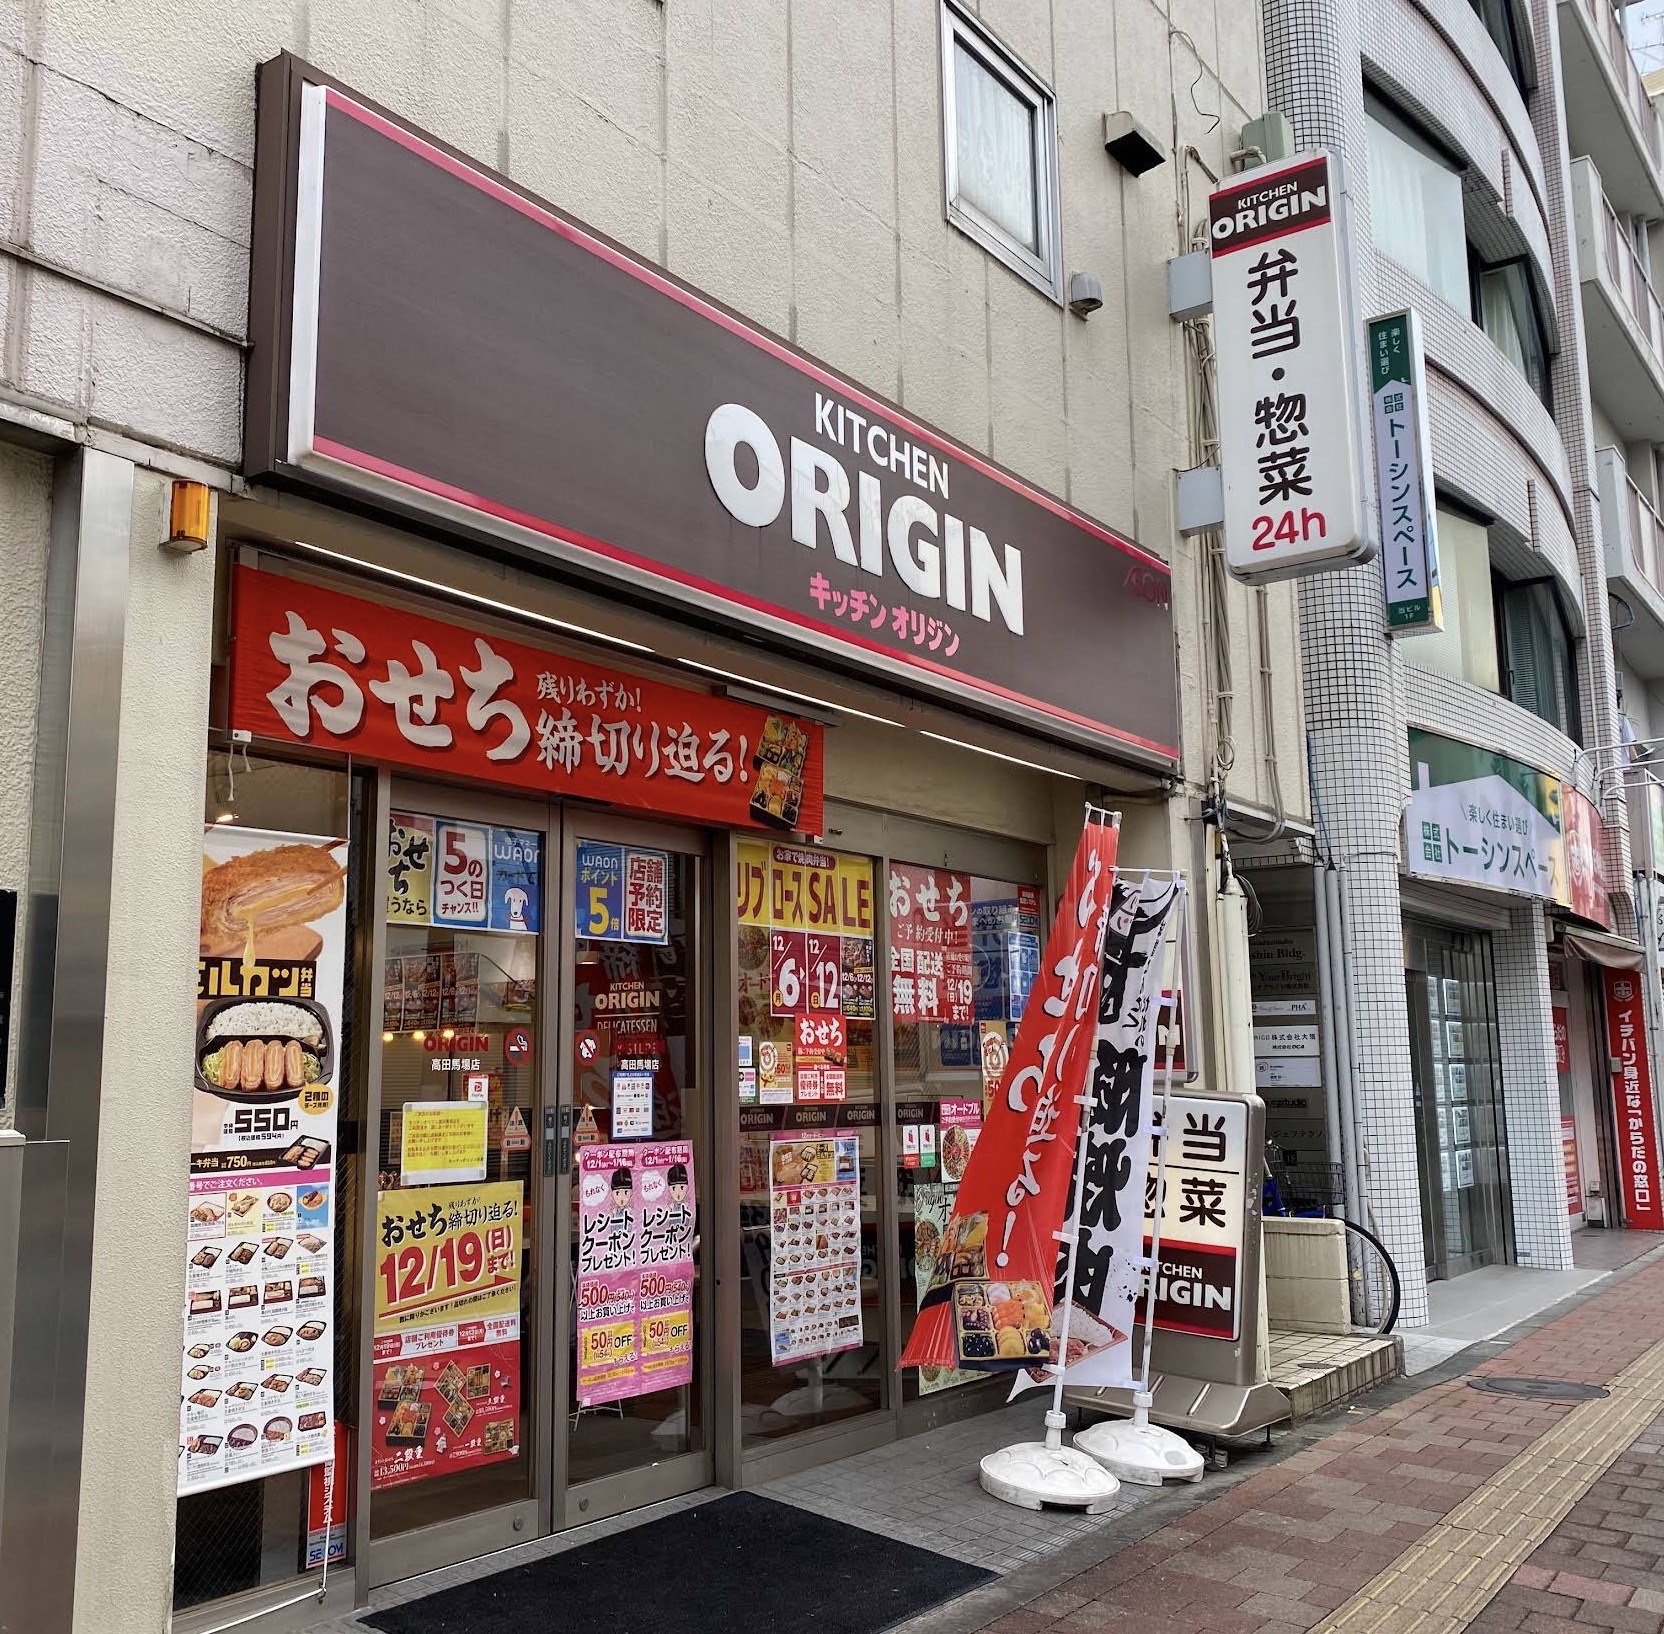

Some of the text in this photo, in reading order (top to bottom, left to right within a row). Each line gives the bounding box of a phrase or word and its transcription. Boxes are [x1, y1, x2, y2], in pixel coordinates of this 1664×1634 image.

[1238, 181, 1298, 210] KITCHEN
[1212, 185, 1327, 240] ORIGIN
[1247, 248, 1313, 506] 弁当・惣菜
[815, 392, 950, 500] KITCHEN
[1388, 418, 1417, 589] トーシンスペース
[703, 402, 1025, 638] ORIGIN
[1252, 507, 1327, 552] 24h
[809, 571, 961, 657] キッチン オリジン
[266, 610, 532, 762] おせち
[535, 707, 750, 785] 締切り迫る!
[443, 831, 483, 879] 5の
[582, 854, 618, 870] WAON
[1445, 827, 1560, 888] トーシンスペース
[581, 867, 618, 887] ポイント
[440, 880, 484, 900] つく日
[809, 871, 871, 929] SALE
[889, 870, 968, 927] おせち
[387, 896, 428, 916] うなら
[1276, 948, 1306, 961] Bldg.
[610, 981, 645, 992] KITCHEN
[892, 974, 940, 1017] 無料
[594, 990, 660, 1010] ORIGIN
[800, 1017, 843, 1047] おせち
[431, 1058, 481, 1071] 高田馬場店
[620, 1059, 660, 1071] 高田馬場店
[740, 1112, 774, 1125] ORIGIN
[795, 1111, 827, 1122] ORIGIN
[847, 1109, 876, 1121] ORIGIN
[897, 1107, 924, 1119] ORIGIN
[381, 1203, 448, 1248] おせち
[448, 1199, 518, 1231] 締切り迫る!
[584, 1209, 635, 1235] レシート
[643, 1204, 692, 1228] レシート
[581, 1230, 636, 1257] クーポン
[640, 1224, 692, 1249] クーポン
[487, 1250, 516, 1275] まで!
[581, 1250, 637, 1273] プレゼント!
[640, 1242, 691, 1265] プレゼント!
[380, 1231, 483, 1306] 12/19
[1138, 1276, 1232, 1311] RIGIN
[613, 1334, 633, 1349] OFF
[670, 1324, 688, 1338] OFF
[415, 1339, 445, 1351] プレゼント
[310, 1542, 344, 1562] SEOM
